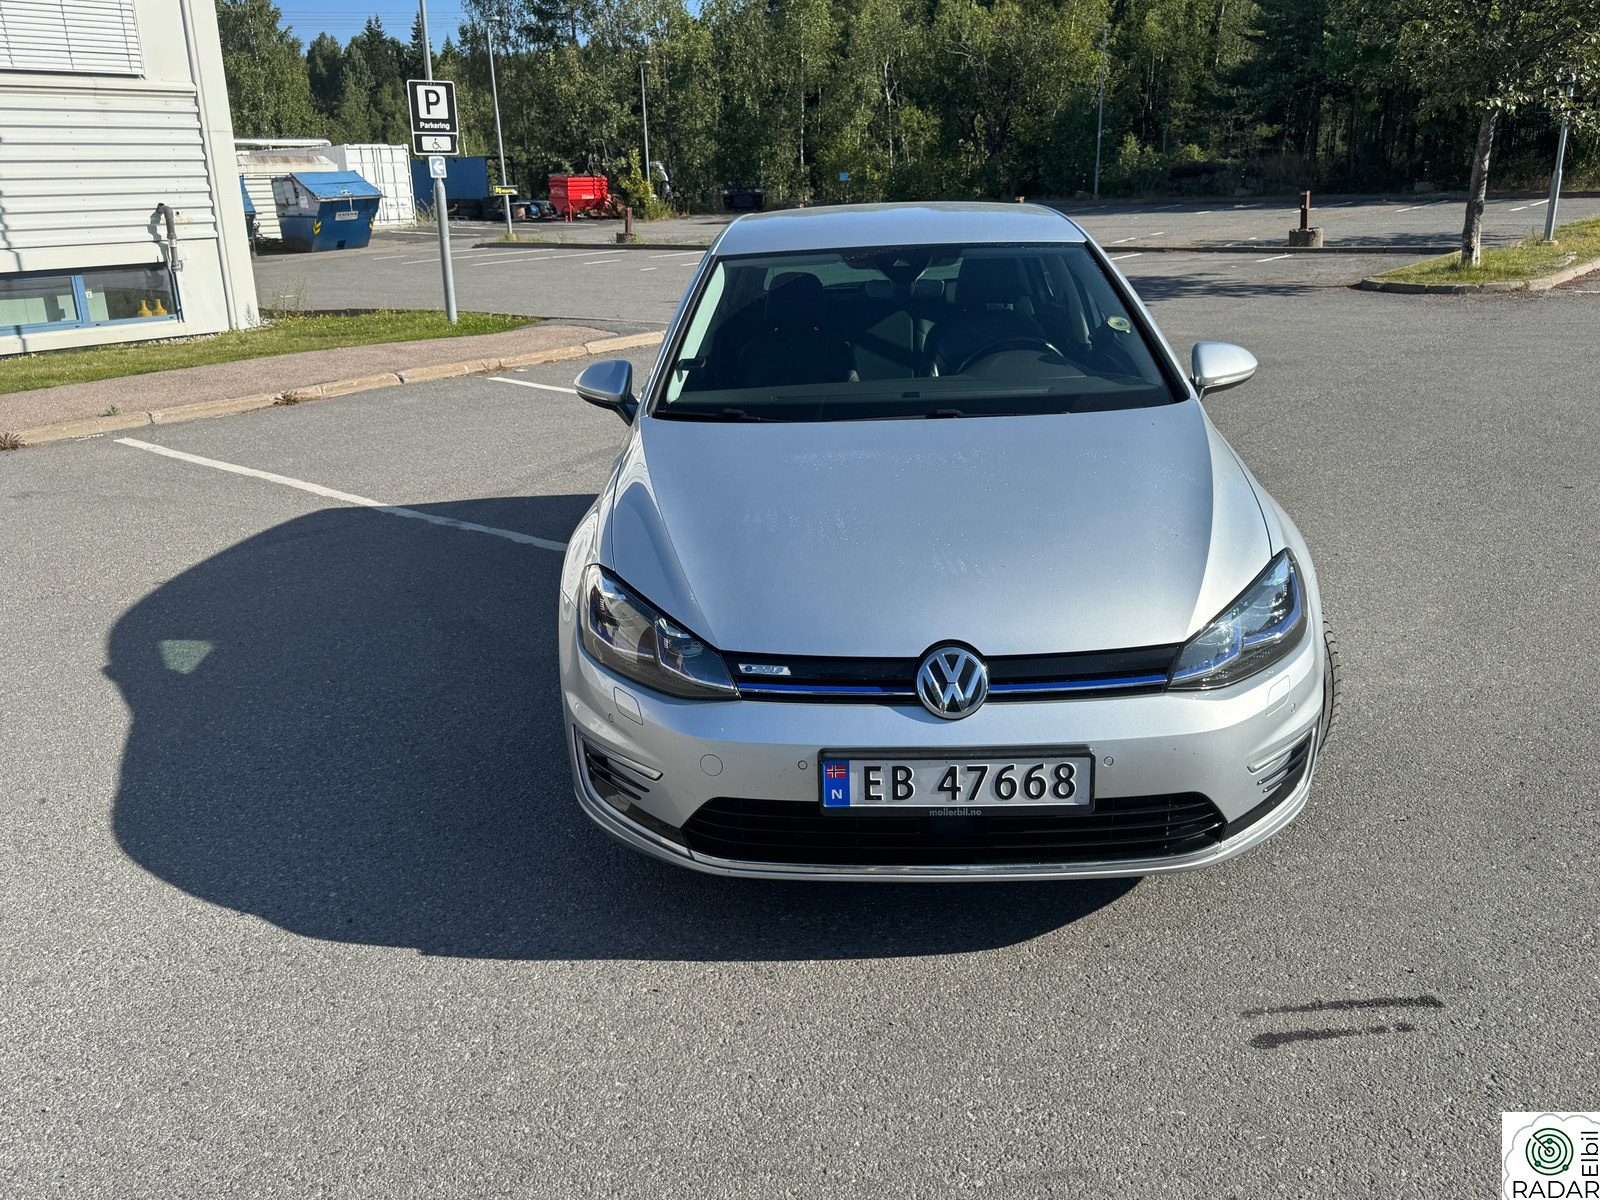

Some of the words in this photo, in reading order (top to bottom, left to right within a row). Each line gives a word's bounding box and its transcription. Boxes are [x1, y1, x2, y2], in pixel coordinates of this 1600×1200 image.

[424, 89, 441, 115] P
[420, 121, 450, 131] Parkering
[919, 648, 986, 716] VW
[831, 789, 843, 800] N
[864, 765, 915, 801] EB
[937, 762, 1077, 801] 47668
[929, 807, 982, 816] mollerbil.no
